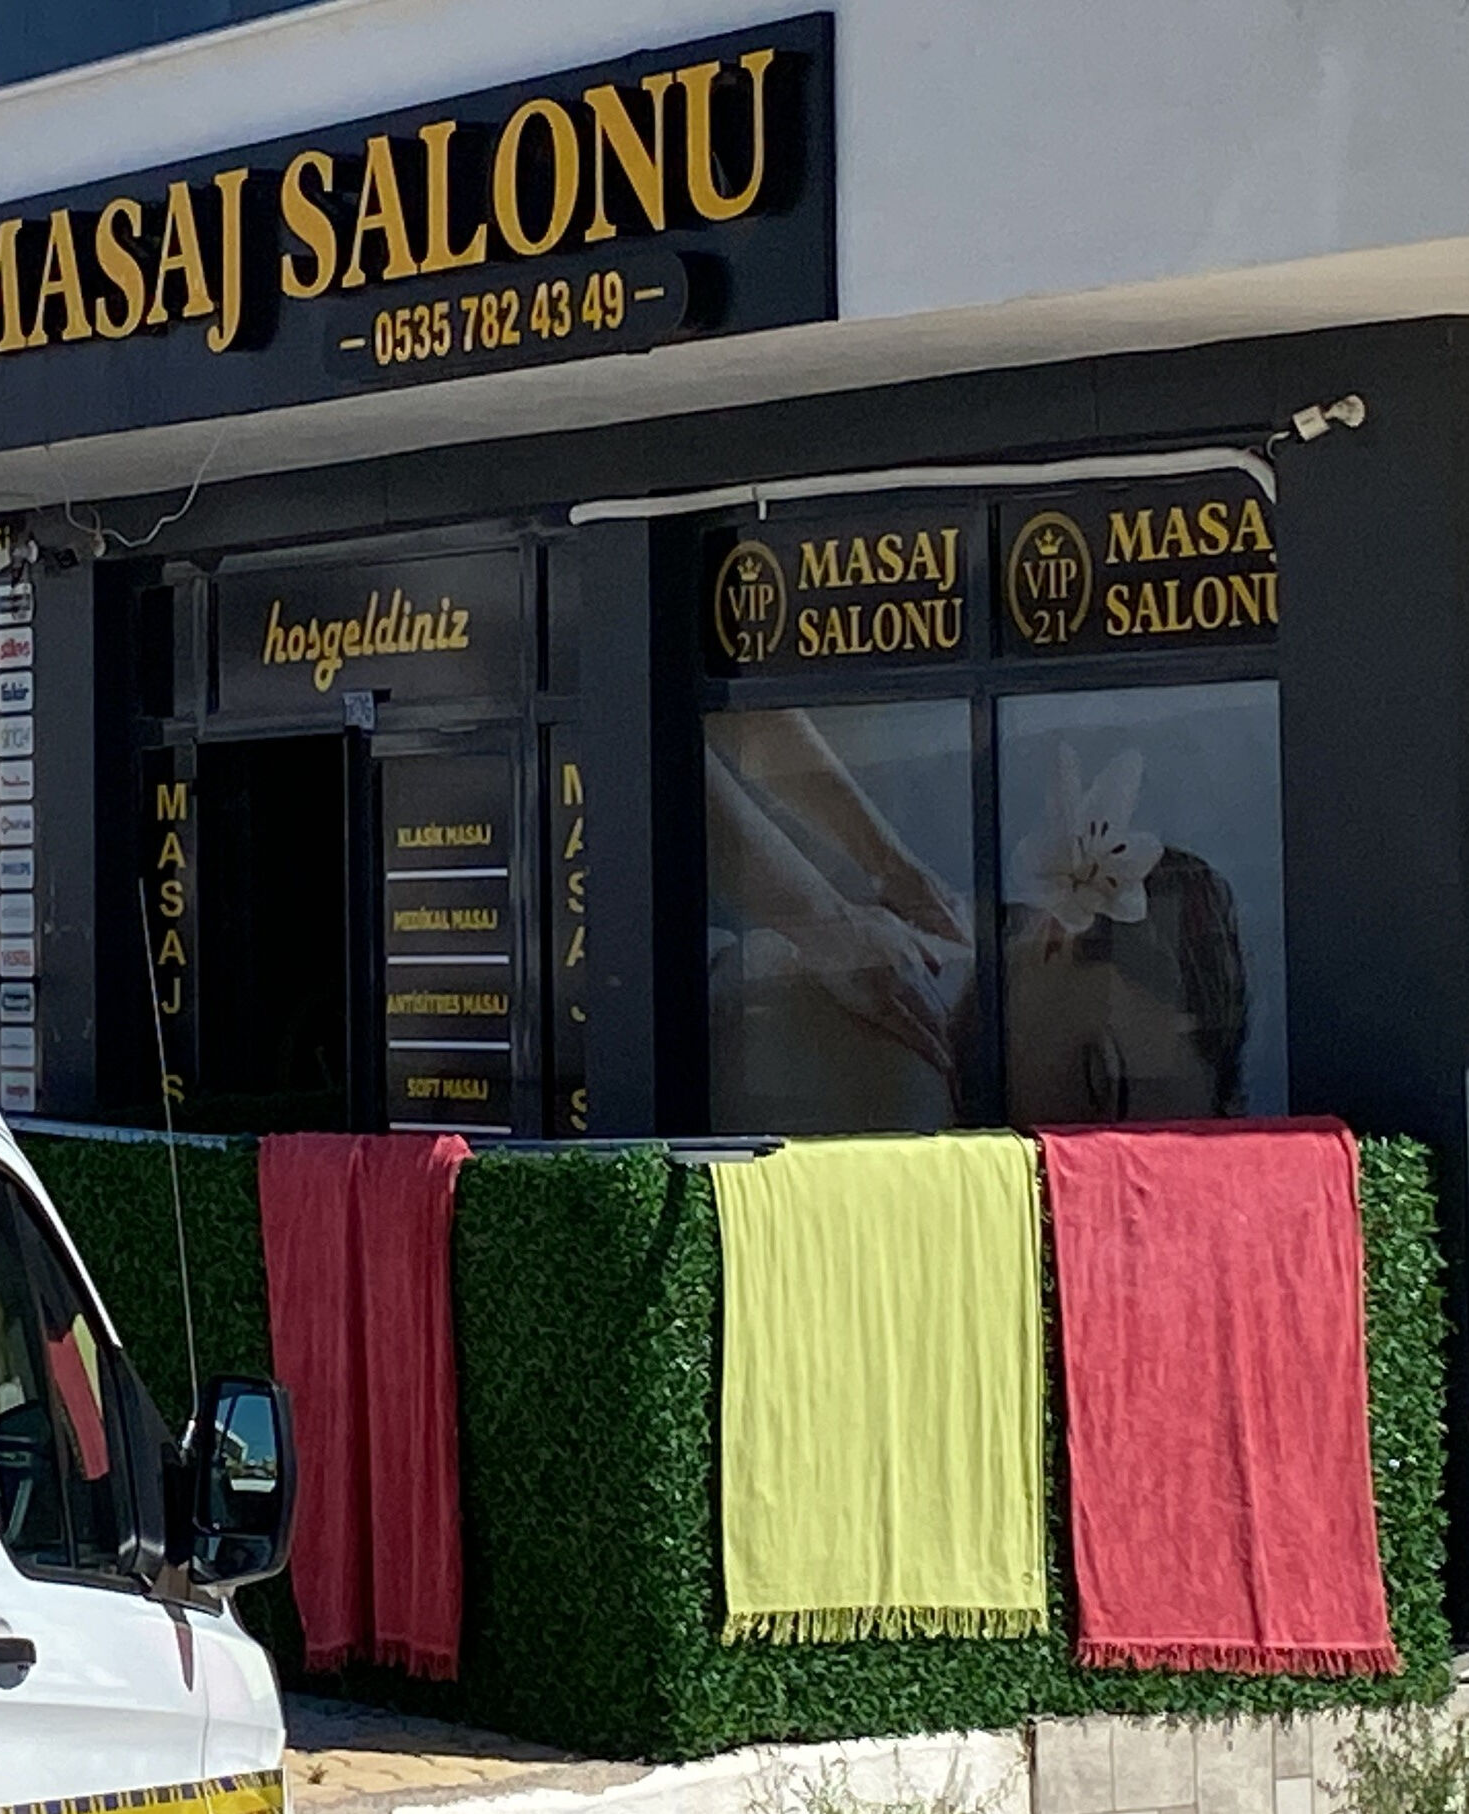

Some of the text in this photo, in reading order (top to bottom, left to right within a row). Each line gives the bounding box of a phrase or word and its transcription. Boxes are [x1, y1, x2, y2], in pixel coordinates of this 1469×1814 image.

[280, 48, 774, 300] SALONU
[374, 300, 451, 367] 0535
[459, 288, 520, 353] 782
[531, 279, 571, 339] 43
[582, 270, 625, 332] 49
[797, 527, 959, 592] MASAJ
[1104, 498, 1277, 565] MASA
[727, 583, 774, 623] VIP
[1022, 556, 1078, 600] VIP
[263, 588, 469, 693] hosgeldiniz
[735, 631, 766, 663] 21
[797, 597, 963, 659] SALONU
[1033, 609, 1067, 646] 21
